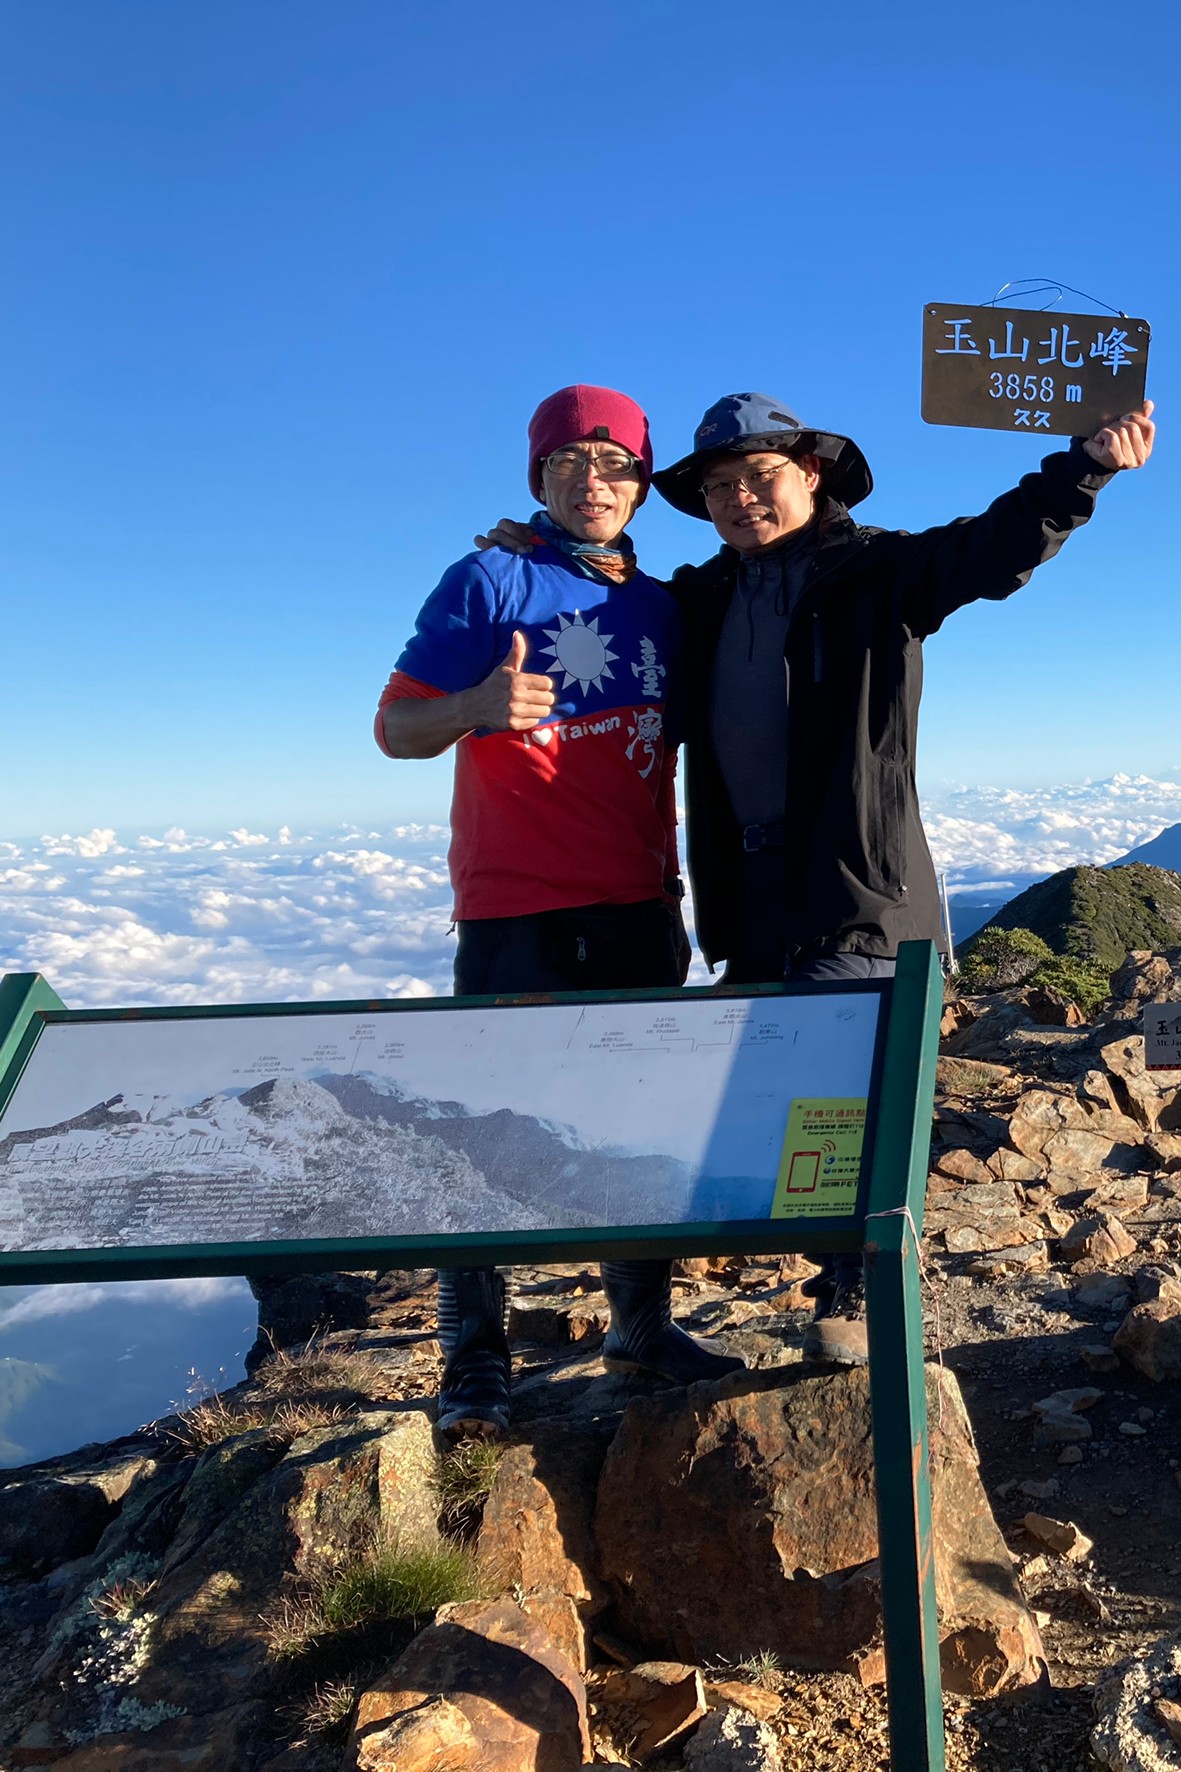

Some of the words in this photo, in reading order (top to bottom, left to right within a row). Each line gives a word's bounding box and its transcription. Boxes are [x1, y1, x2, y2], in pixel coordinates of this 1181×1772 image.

[935, 318, 1139, 376] 玉山北峰
[988, 372, 1054, 402] 3858
[1065, 384, 1082, 403] m
[625, 635, 667, 779] 臺灣
[523, 732, 531, 749] I
[554, 715, 621, 742] Taiwan
[1157, 1039, 1169, 1047] Mt.
